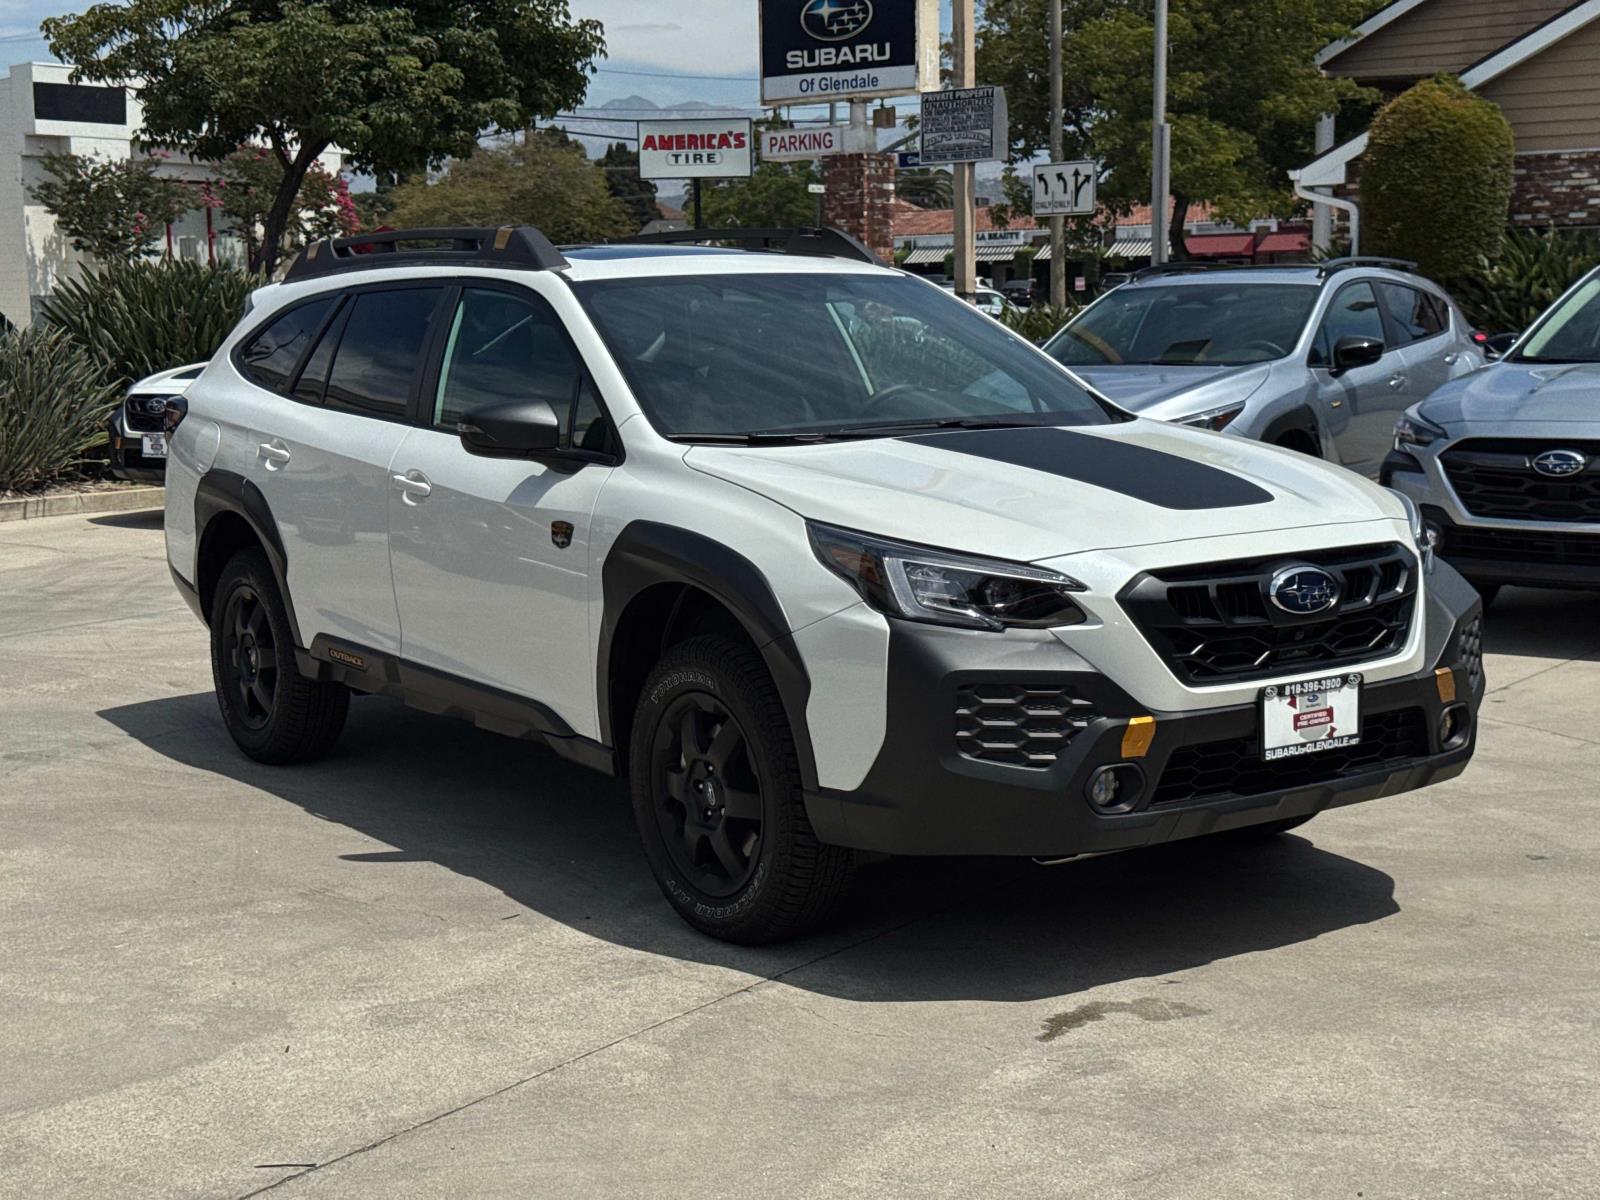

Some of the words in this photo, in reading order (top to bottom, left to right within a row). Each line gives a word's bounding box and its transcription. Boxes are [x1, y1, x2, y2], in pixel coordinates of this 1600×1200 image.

[786, 42, 890, 70] SUBARU
[799, 77, 815, 93] Of
[818, 73, 879, 91] Glendale
[924, 91, 954, 102] PRIVATE
[955, 87, 993, 100] PROPERTY
[924, 98, 992, 111] UNAUTHORIZED
[642, 130, 747, 151] AMERICA'S
[769, 131, 834, 153] PARKING
[671, 153, 717, 164] TIRE
[1035, 201, 1052, 209] ONLY
[1053, 200, 1071, 209] ONLY
[988, 231, 1020, 241] BEAUTY
[650, 671, 715, 705] YOKOHAMA
[1285, 678, 1341, 695] 818-396-3900
[1297, 716, 1330, 727] PRE-OWNED
[1299, 710, 1328, 721] CERTIFIED
